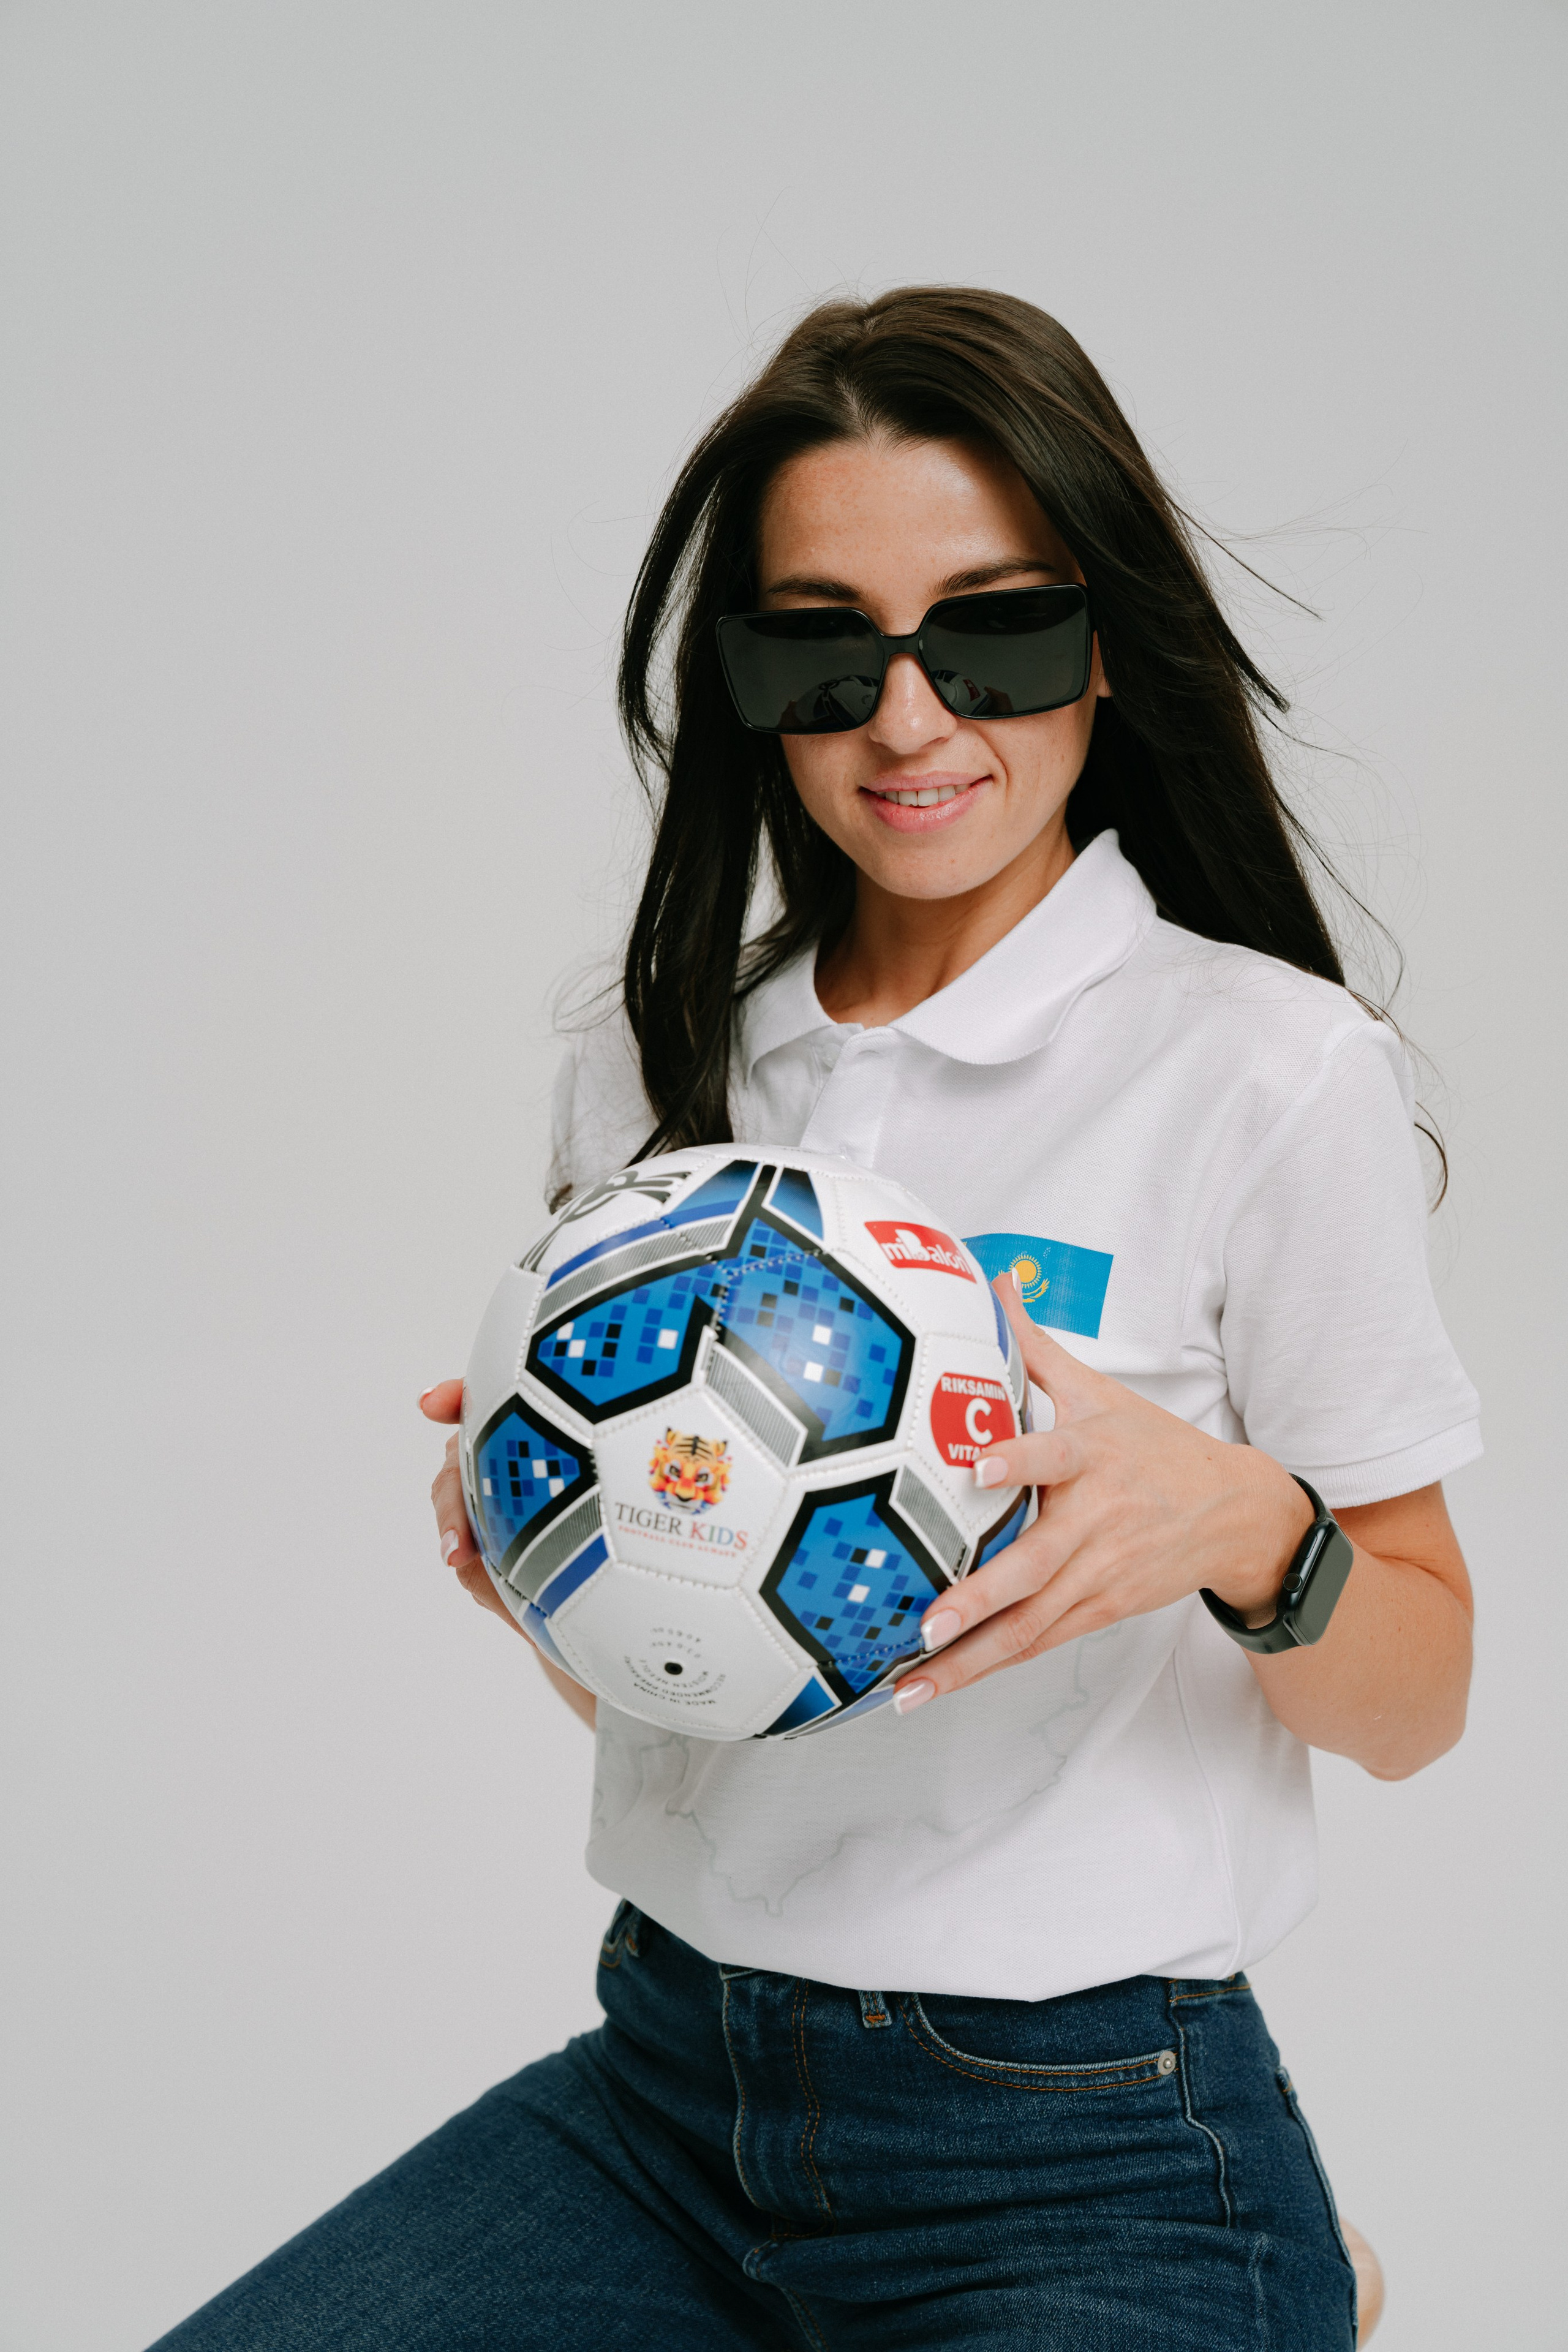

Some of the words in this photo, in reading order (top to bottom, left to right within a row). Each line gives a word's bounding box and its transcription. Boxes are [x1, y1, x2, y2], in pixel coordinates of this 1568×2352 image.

[941, 1376, 1006, 1401] RIKSAMIN
[965, 1397, 993, 1446] C
[948, 1443, 986, 1461] VITA
[616, 1502, 682, 1537] TIGER
[690, 1521, 748, 1551] KIDS
